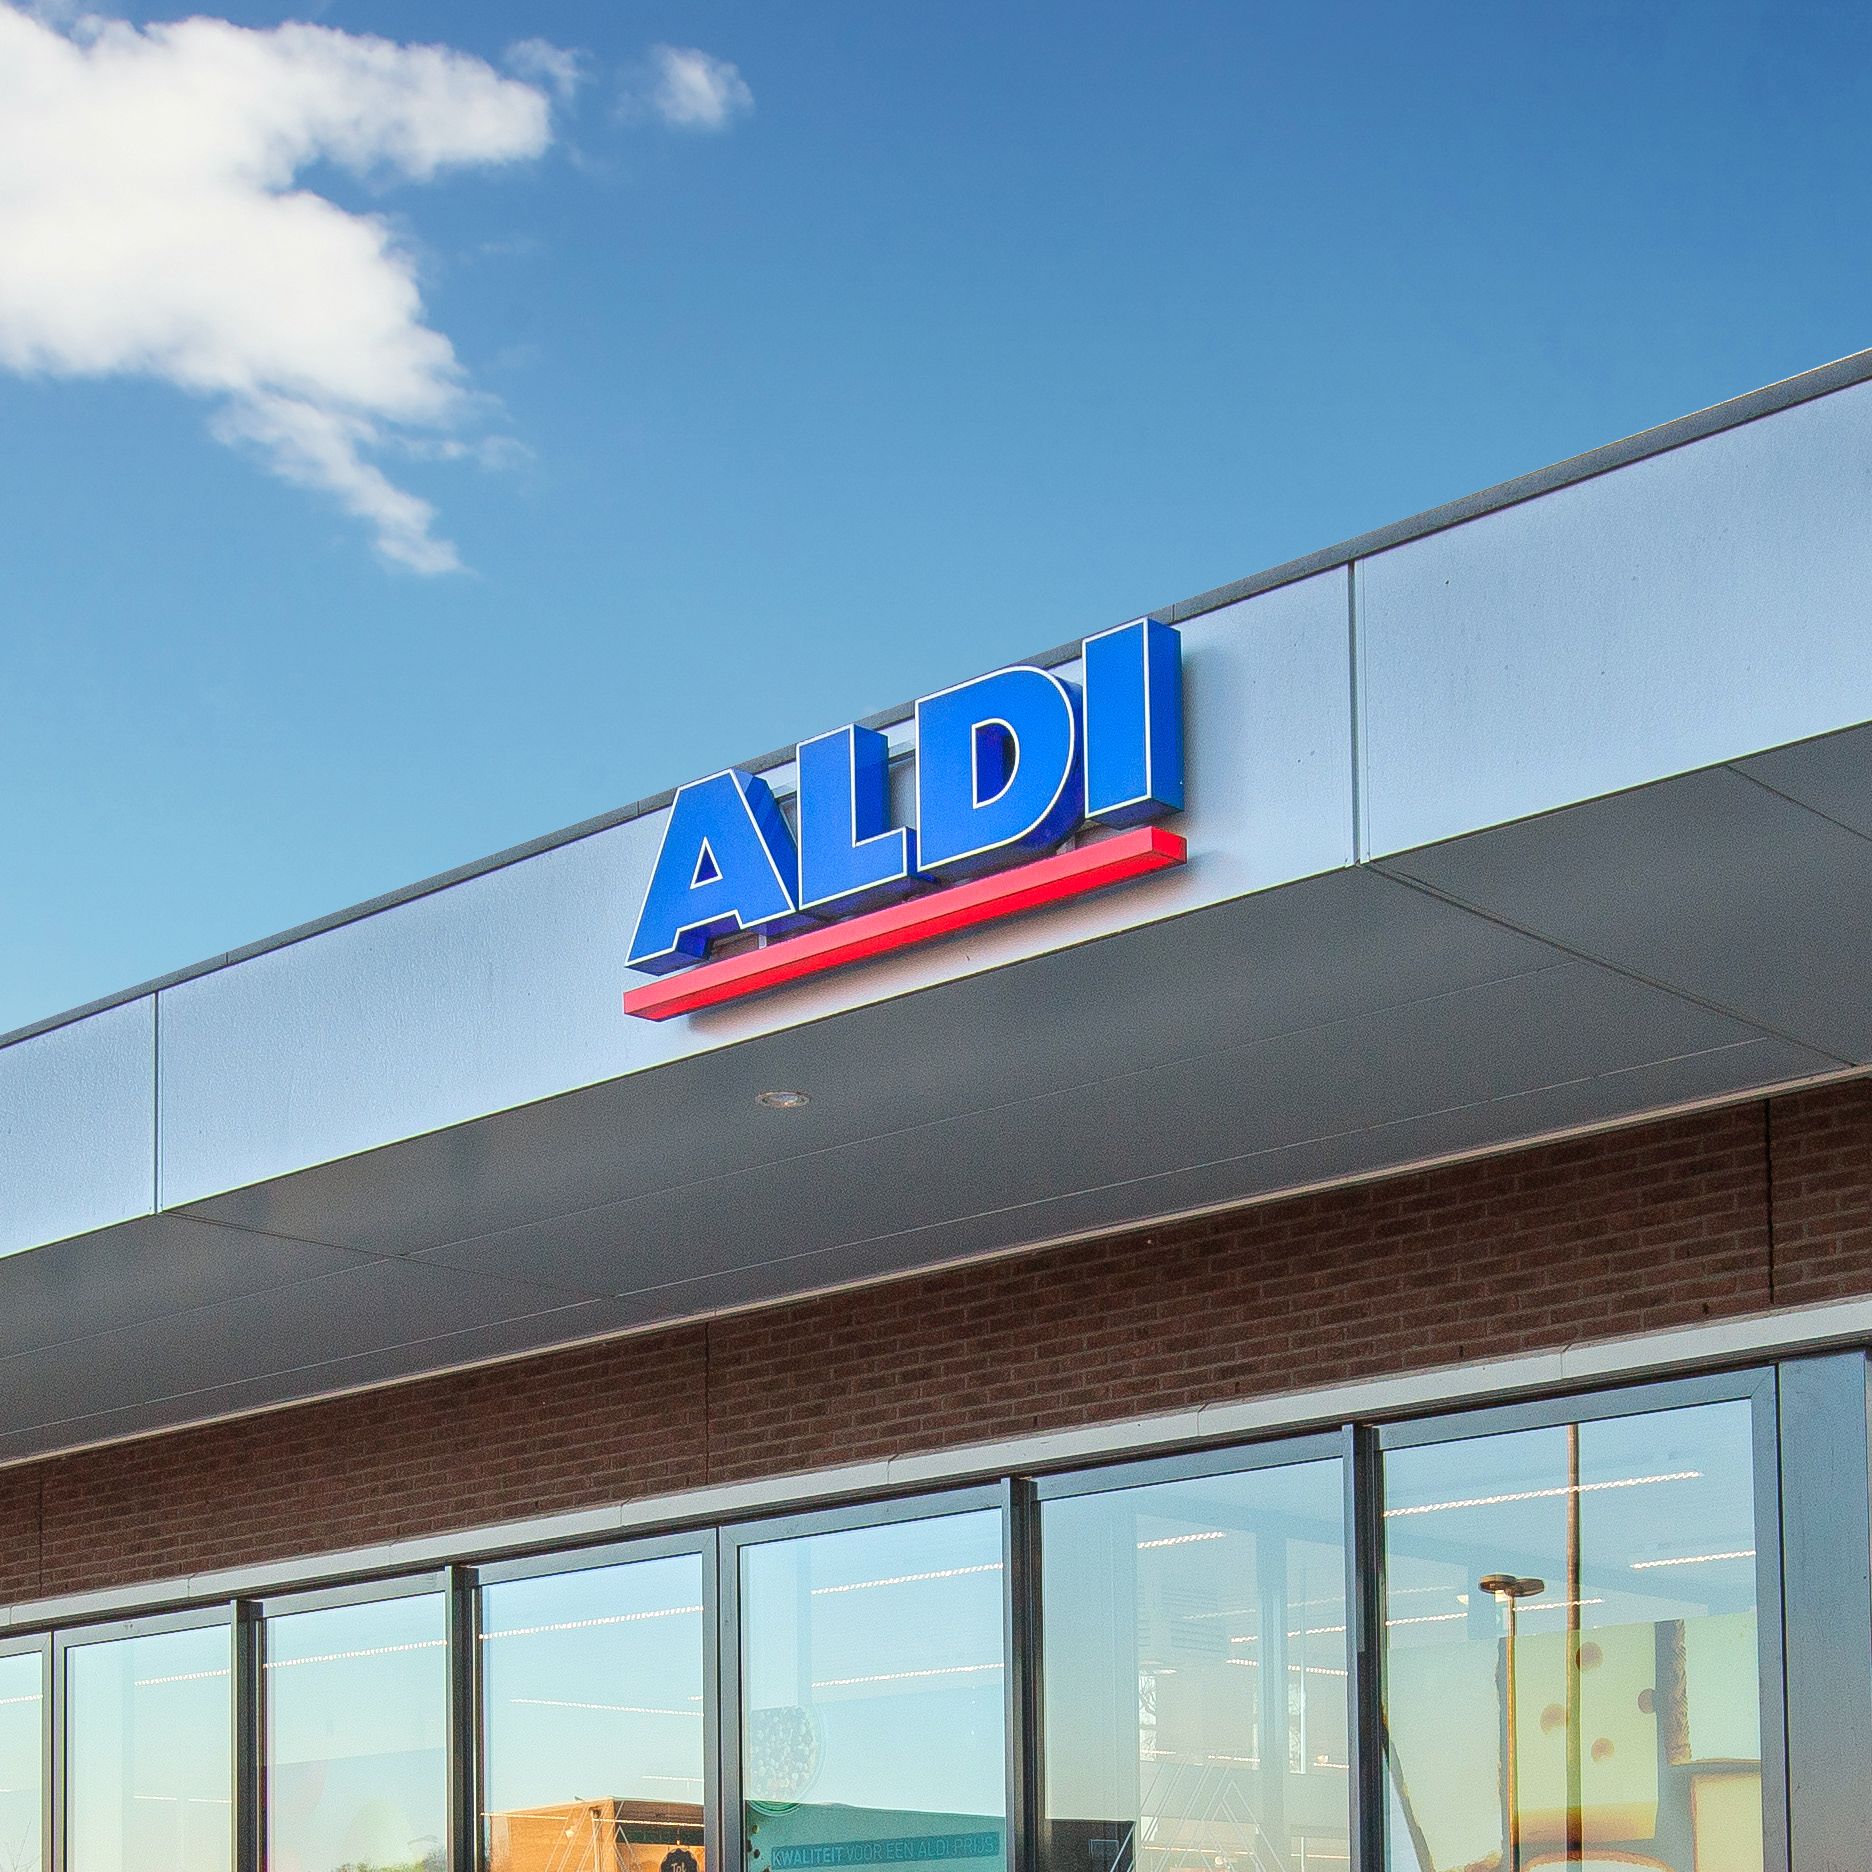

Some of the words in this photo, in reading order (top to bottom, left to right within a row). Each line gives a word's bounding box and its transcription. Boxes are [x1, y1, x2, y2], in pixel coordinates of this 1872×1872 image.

[624, 616, 1183, 976] ALDI
[772, 1847, 842, 1866] KWALITEIT
[847, 1844, 883, 1862] VOOR
[887, 1842, 913, 1860] EEN
